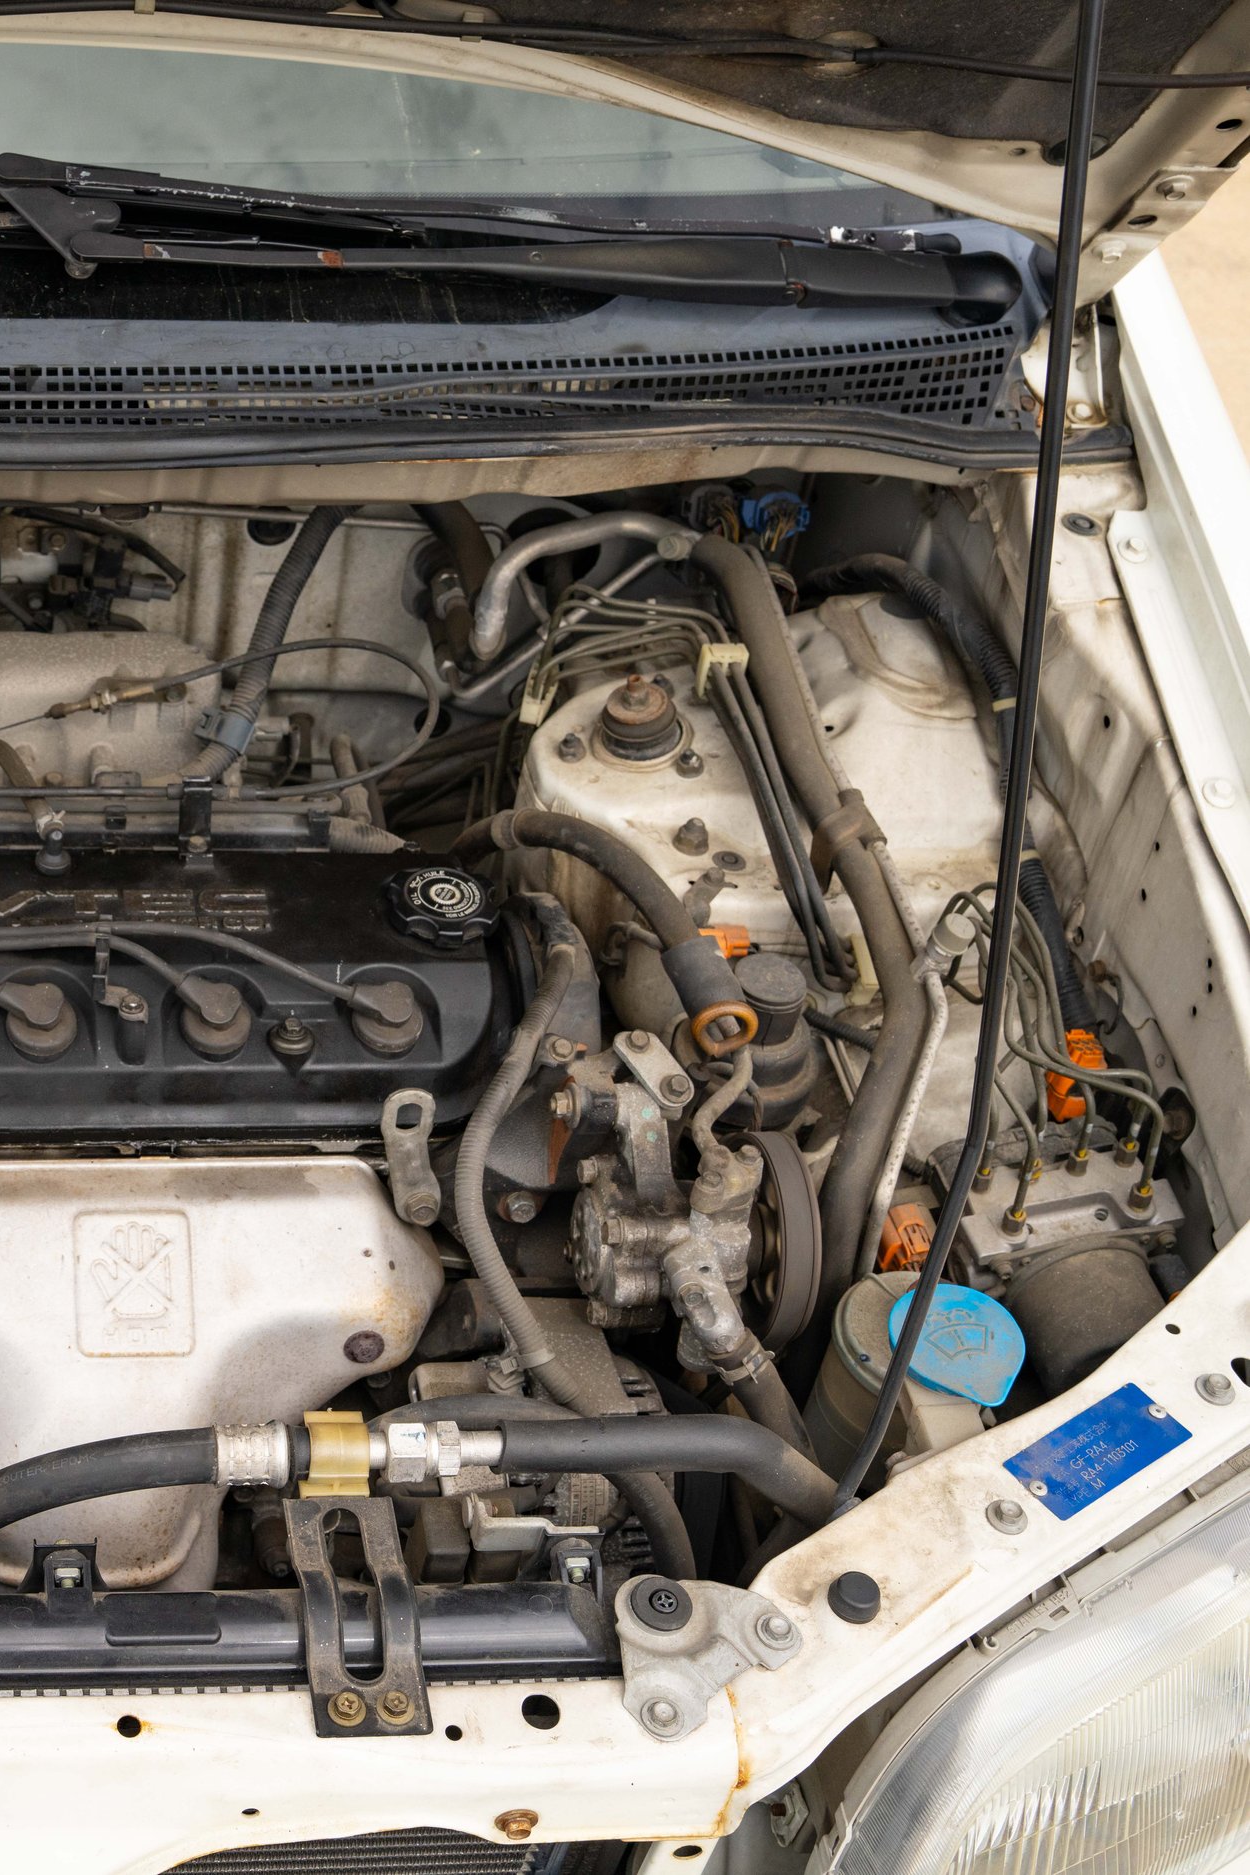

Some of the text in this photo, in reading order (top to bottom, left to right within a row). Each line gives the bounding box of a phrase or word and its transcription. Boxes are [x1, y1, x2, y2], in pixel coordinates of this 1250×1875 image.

[410, 893, 422, 906] OIL
[1069, 1440, 1109, 1470] GF-RA4
[1079, 1439, 1139, 1482] RA4-1103101
[1090, 1477, 1106, 1492] M
